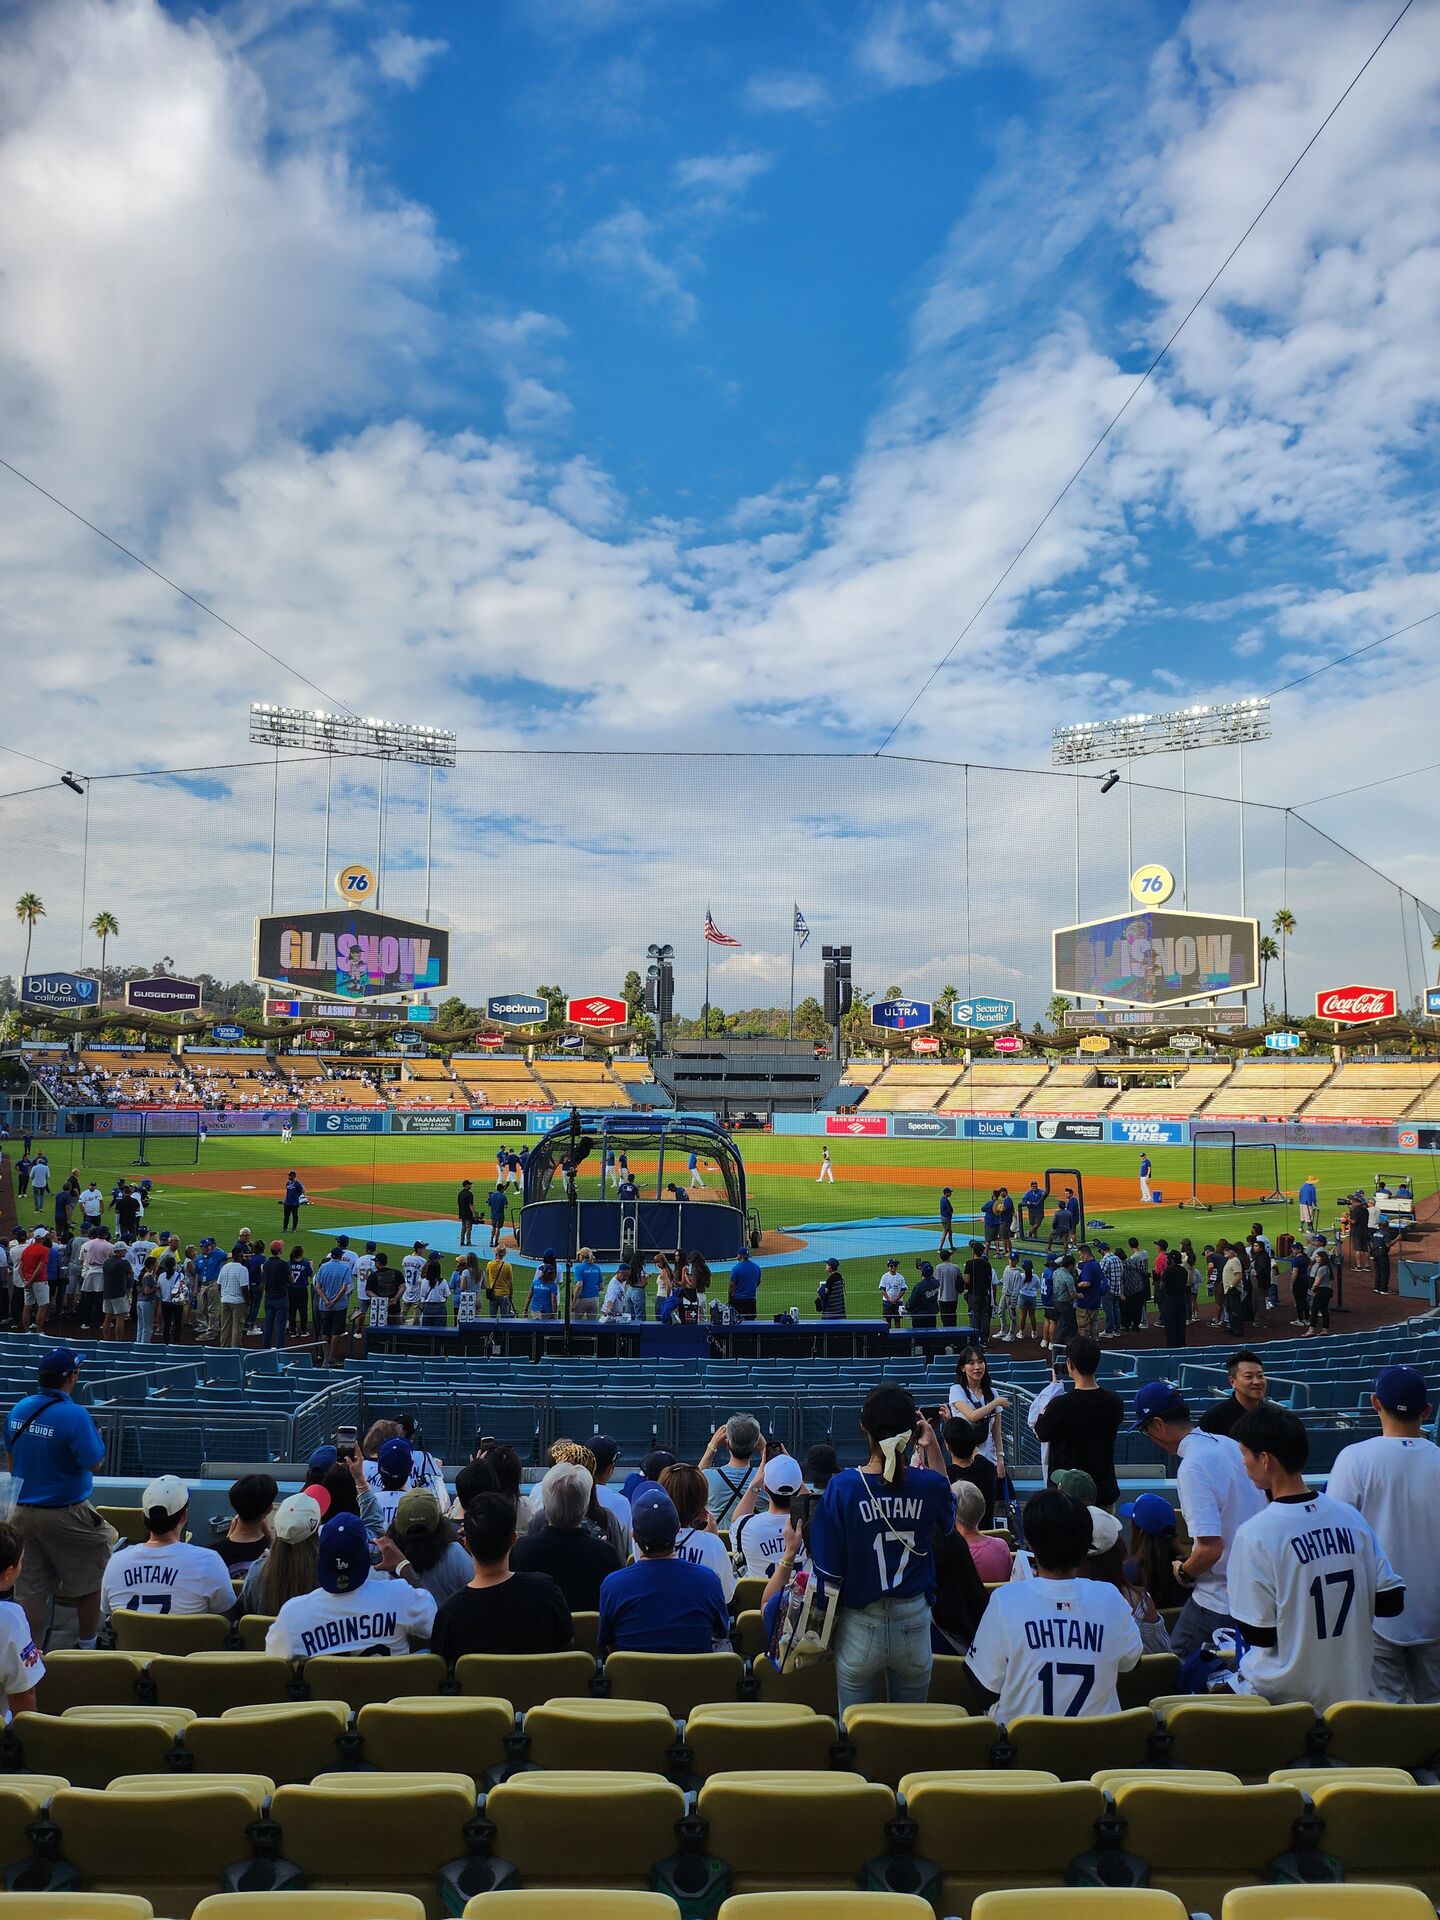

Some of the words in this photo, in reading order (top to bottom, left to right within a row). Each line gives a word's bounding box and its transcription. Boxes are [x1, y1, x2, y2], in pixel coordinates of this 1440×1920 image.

[347, 875, 368, 891] 76
[1141, 875, 1163, 892] 76
[280, 930, 431, 975] GLASNOW
[28, 978, 72, 994] blue
[35, 994, 76, 1003] california
[134, 991, 196, 1000] GUGGENHEIM
[492, 1003, 540, 1014] Spectrum
[975, 1005, 1009, 1014] Security
[1322, 993, 1388, 1015] Coca-Cola
[884, 1008, 918, 1016] ULTRA
[976, 1014, 1005, 1022] Benefit
[1114, 1012, 1154, 1024] GLASNOW
[310, 1031, 330, 1039] JINRO
[912, 1040, 938, 1050] Churu
[1269, 1036, 1297, 1047] TEL
[96, 1118, 110, 1128] 76
[343, 1115, 372, 1124] Security
[472, 1119, 490, 1127] UCLA
[495, 1118, 521, 1127] Health
[343, 1123, 367, 1131] Benefit
[908, 1122, 940, 1131] Spectrum
[978, 1123, 1003, 1132] blue
[1121, 1123, 1160, 1132] TOYO
[1127, 1133, 1169, 1142] TIRES
[1401, 1135, 1415, 1144] 76
[406, 1270, 417, 1285] 21
[10, 1420, 27, 1431] TOU
[29, 1424, 55, 1437] GUIDE
[859, 1497, 923, 1523] OHTANI
[1291, 1527, 1355, 1565] OHTANI
[873, 1531, 915, 1591] 17
[124, 1565, 178, 1587] OHTANI
[1310, 1569, 1355, 1640] 17
[301, 1612, 397, 1657] ROBINSON
[1024, 1619, 1104, 1653] OHTANI
[1038, 1662, 1095, 1717] 17
